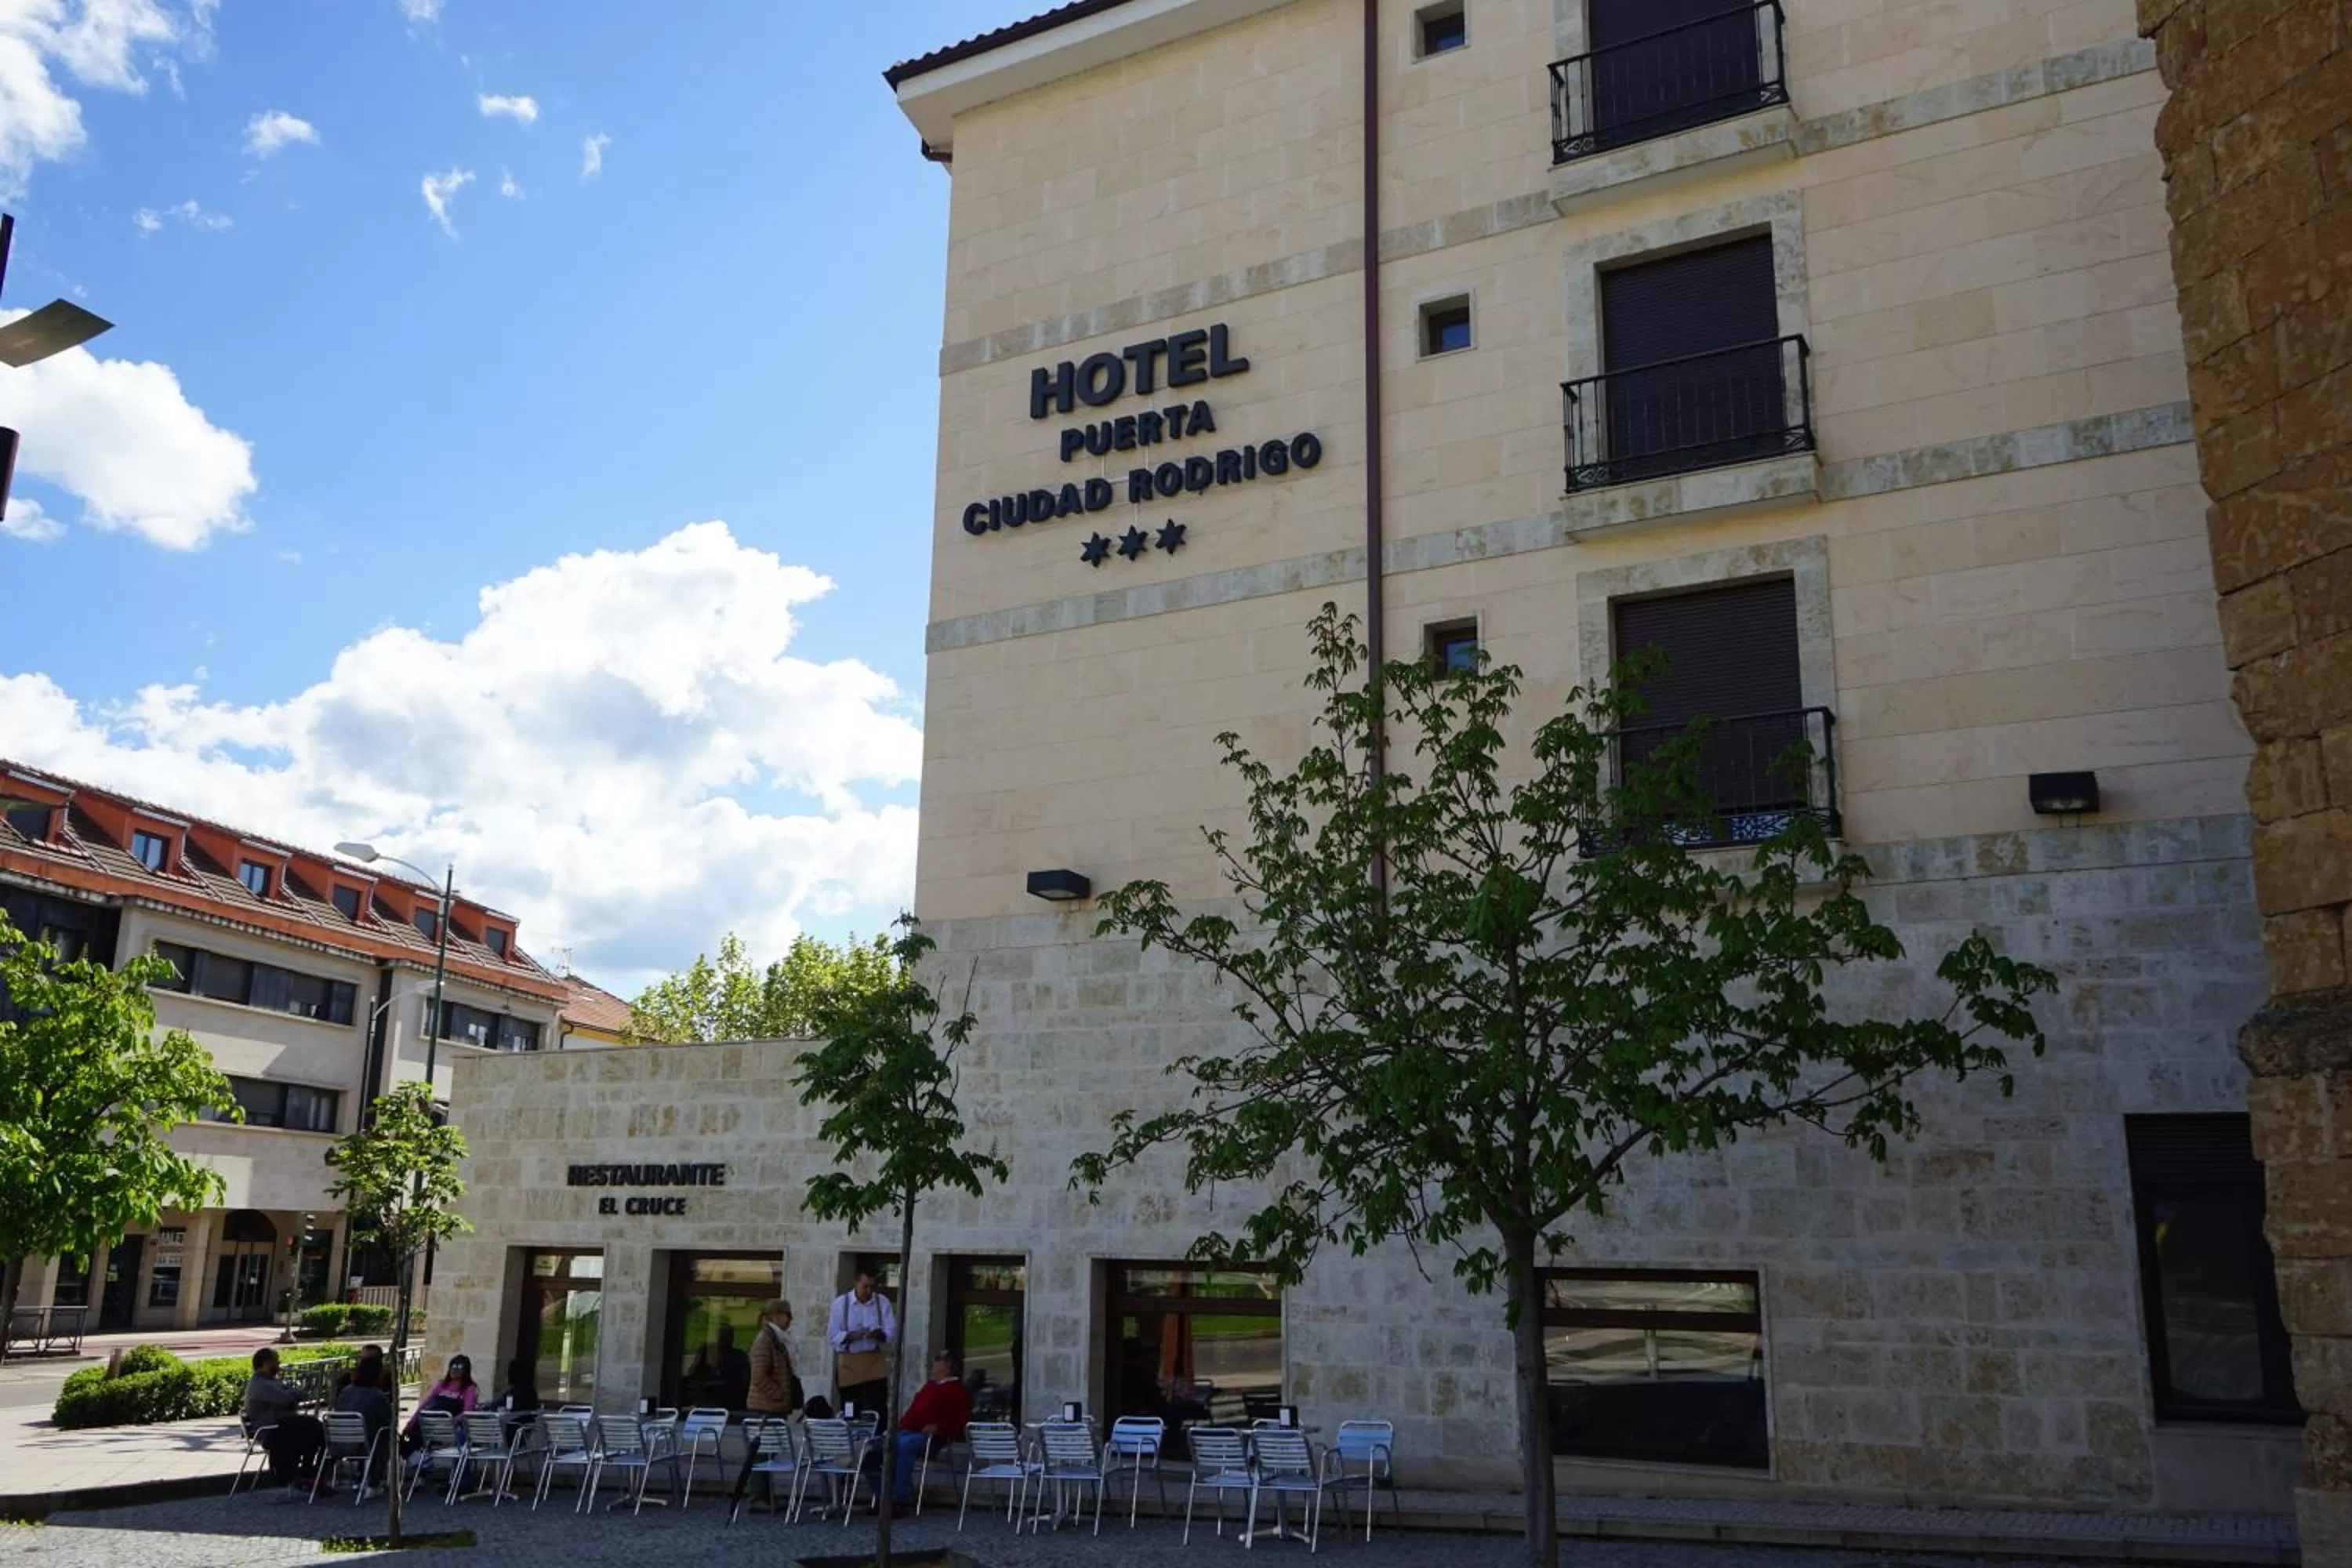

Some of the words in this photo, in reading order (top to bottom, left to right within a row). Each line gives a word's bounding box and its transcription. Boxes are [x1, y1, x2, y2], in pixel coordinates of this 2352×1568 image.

[1029, 322, 1250, 419] HOTEL
[1060, 400, 1217, 463] PUERTA
[963, 478, 1113, 535] CIUDAD
[1128, 432, 1323, 503] RODRIGO
[567, 1163, 726, 1186] RESTAURANTE
[598, 1197, 619, 1214] EL
[625, 1196, 687, 1215] CRUCE
